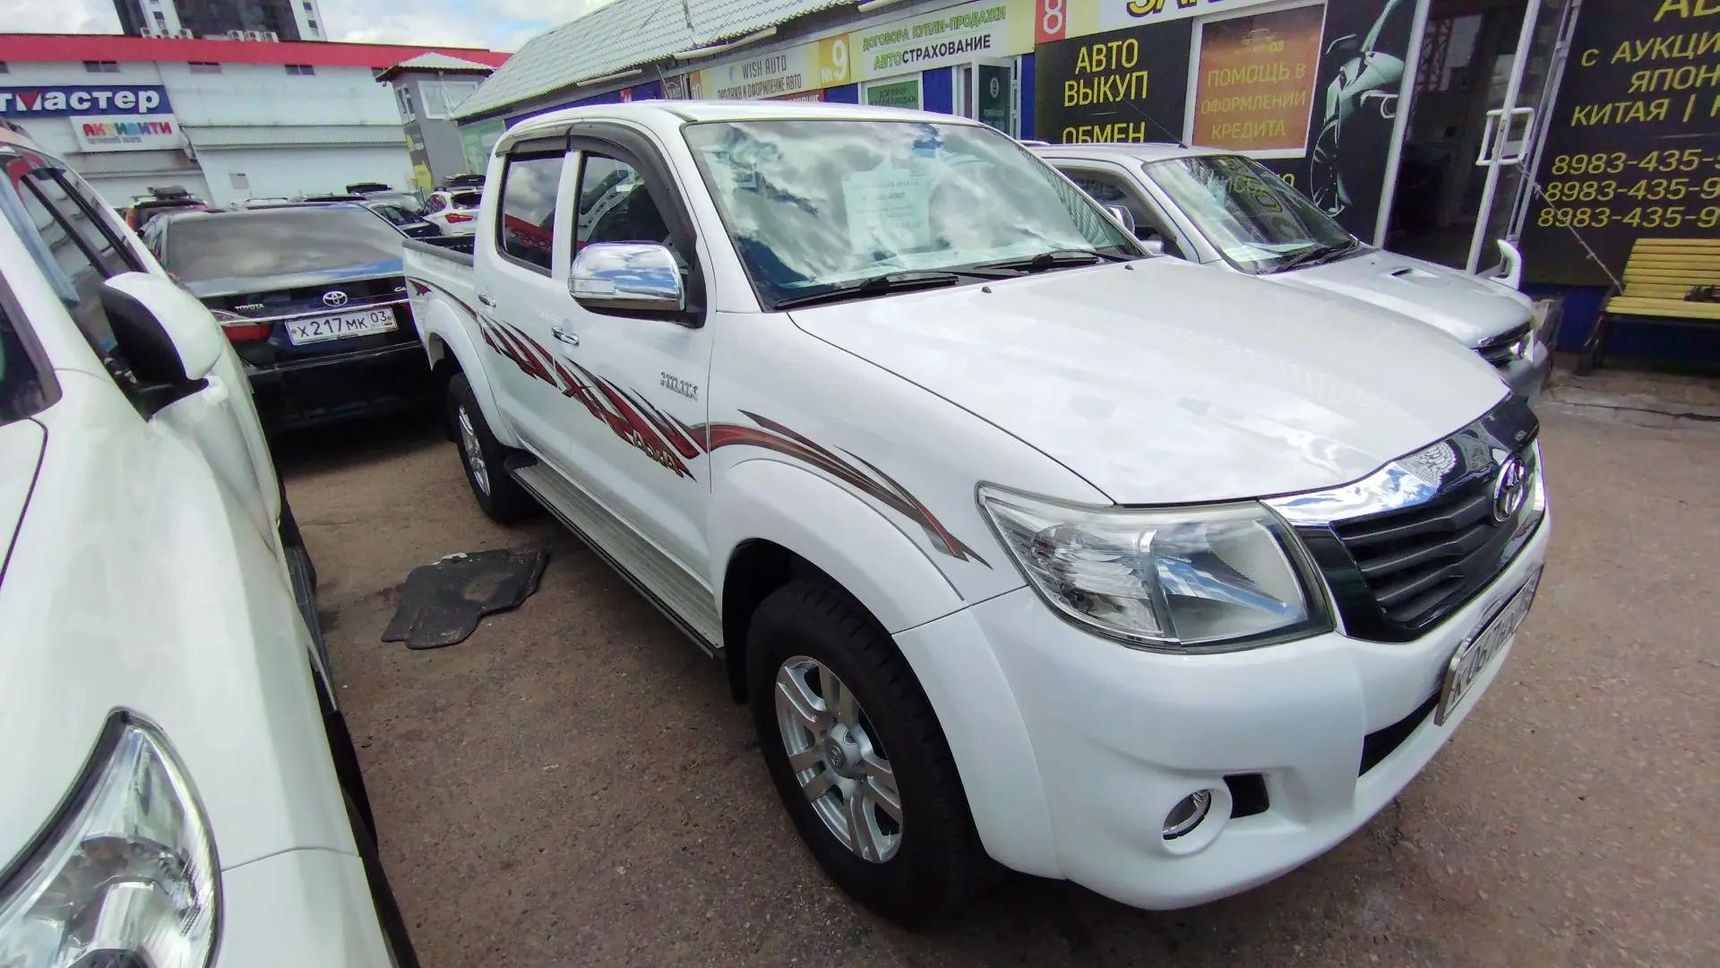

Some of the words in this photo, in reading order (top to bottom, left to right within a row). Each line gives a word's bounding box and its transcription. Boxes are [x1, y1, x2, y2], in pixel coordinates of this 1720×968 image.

[863, 28, 909, 51] ДОГОВОРА
[912, 5, 1006, 39] КУПЛИ-ПРОДАЖИ
[873, 34, 991, 71] АВТОСТРАХОВАНИЕ
[1075, 38, 1138, 75] АВТО
[742, 60, 762, 80] WISH
[1207, 64, 1290, 88] ПОМОЩЬ
[1628, 64, 1720, 93] ЯПОН
[1064, 70, 1148, 108] ВЫКУП
[1200, 91, 1306, 114] ОФОРМЛЕНИИ
[1570, 98, 1670, 127] КИТАЯ
[1063, 121, 1146, 144] ОБМЕН
[1211, 120, 1287, 140] КРЕДИТА
[1545, 177, 1720, 201] 8983-435-9
[234, 303, 264, 311] TOYOTA
